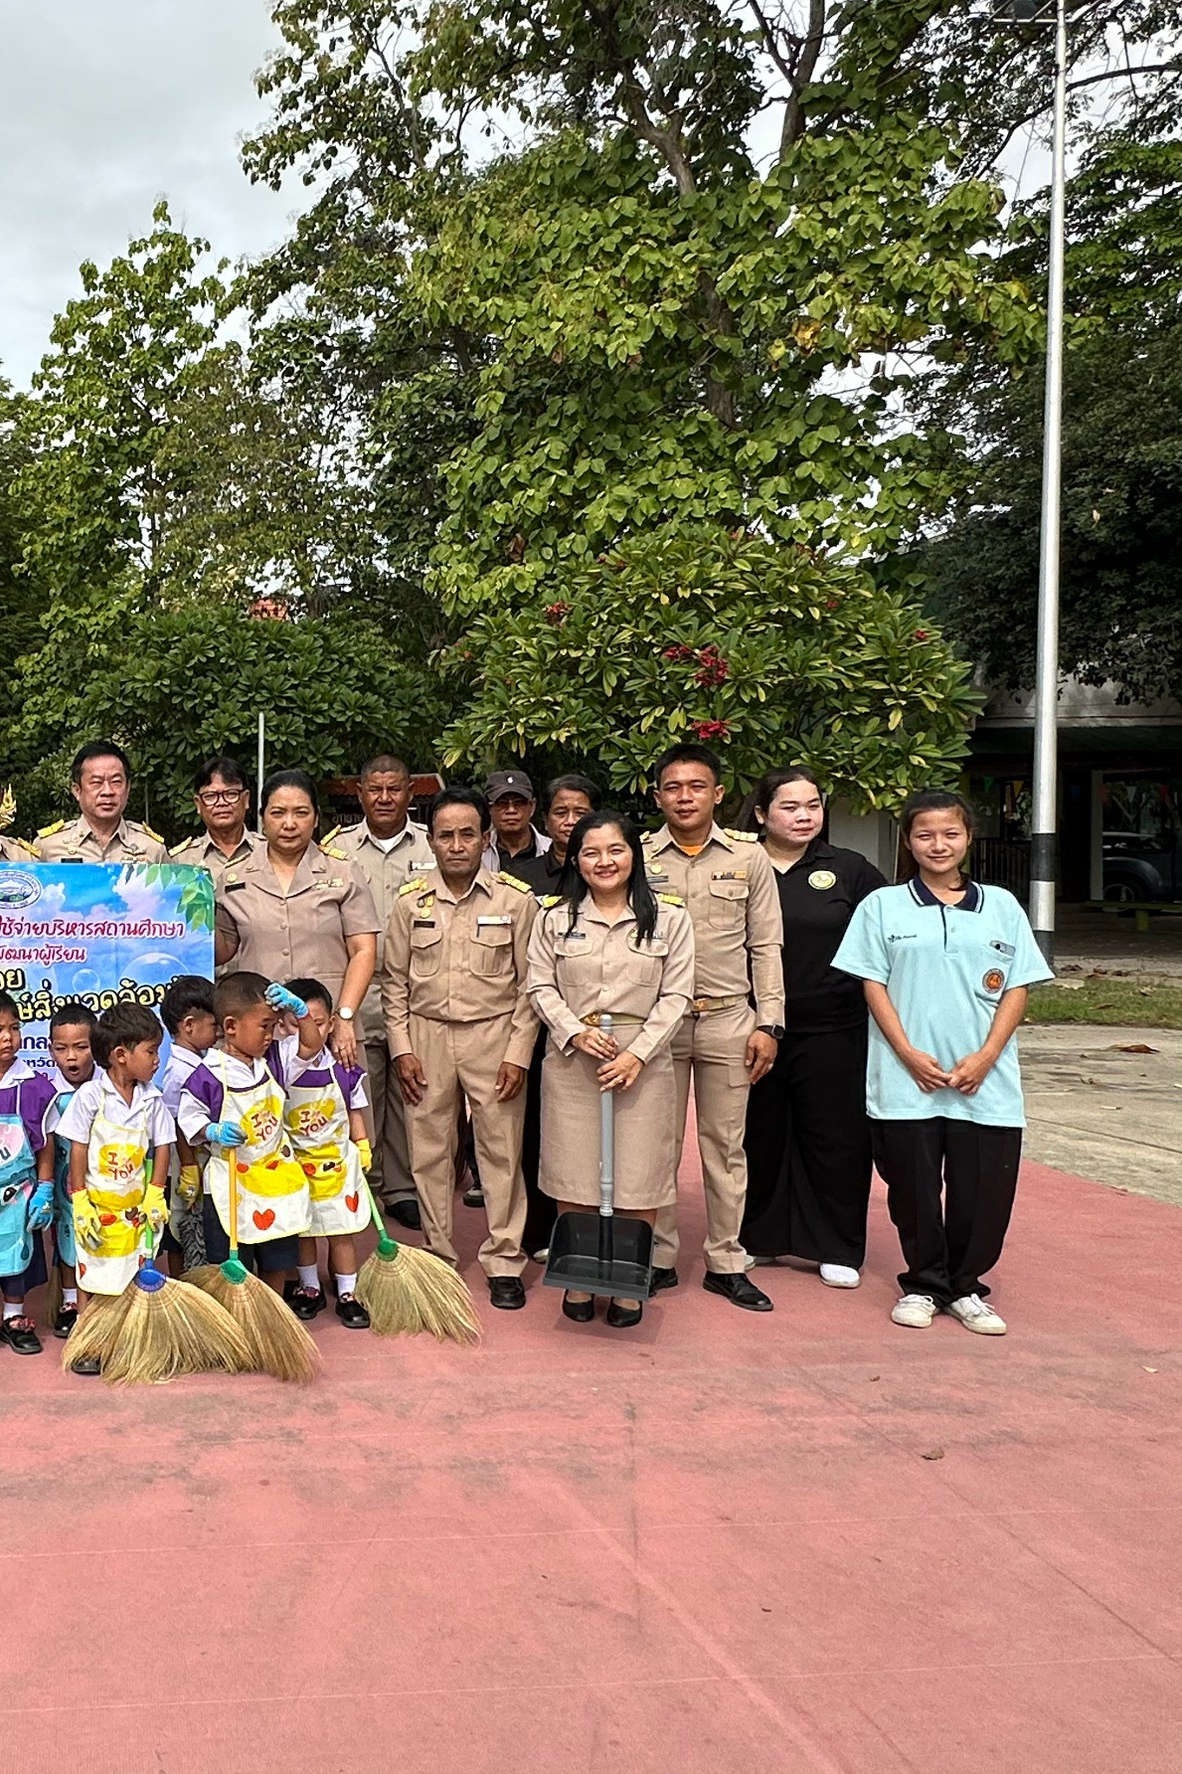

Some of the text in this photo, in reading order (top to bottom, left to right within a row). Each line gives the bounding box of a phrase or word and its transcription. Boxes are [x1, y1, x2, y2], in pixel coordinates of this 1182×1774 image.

[250, 1113, 262, 1128] I
[300, 1111, 311, 1123] I
[256, 1116, 279, 1141] YOU
[299, 1116, 328, 1137] YOU
[108, 1152, 119, 1166] I
[108, 1163, 134, 1180] YOU
